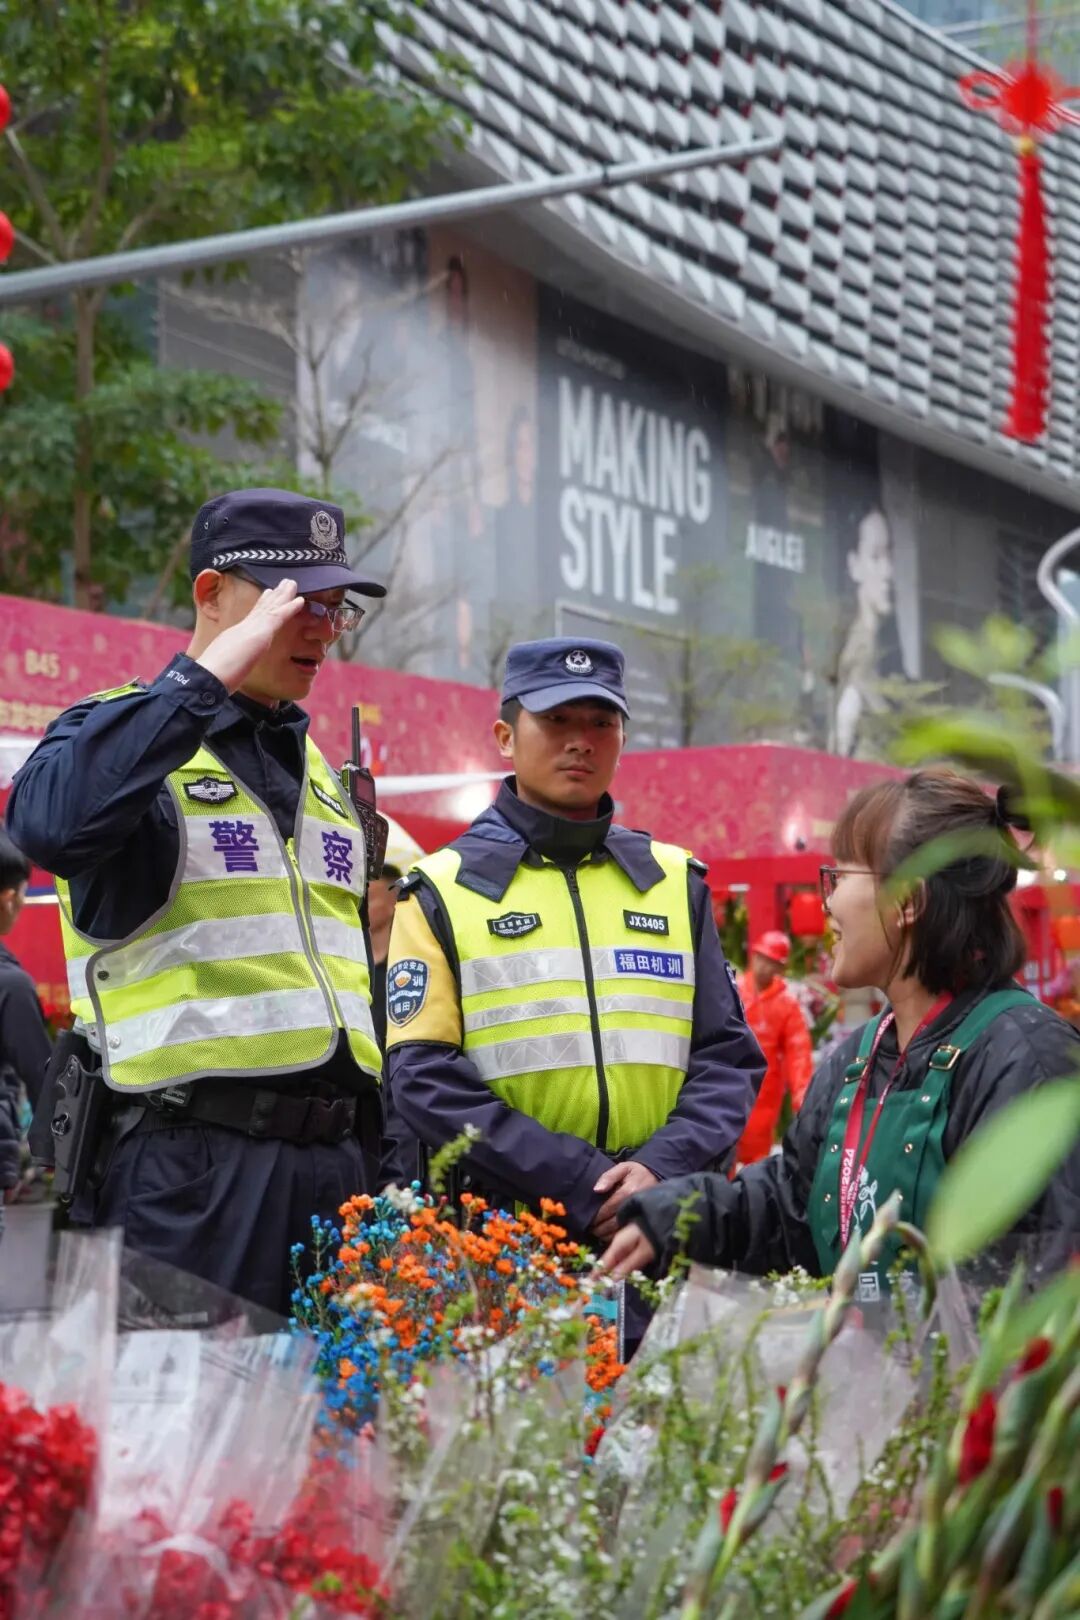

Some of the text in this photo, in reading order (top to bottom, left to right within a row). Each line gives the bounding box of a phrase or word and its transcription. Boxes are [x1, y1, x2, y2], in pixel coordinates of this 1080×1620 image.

[558, 375, 711, 525] MAKING
[559, 485, 680, 615] STYLE
[208, 820, 354, 885] 警 察
[628, 914, 666, 931] JX3405
[618, 952, 682, 975] 福田机训
[841, 1148, 855, 1186] 2024
